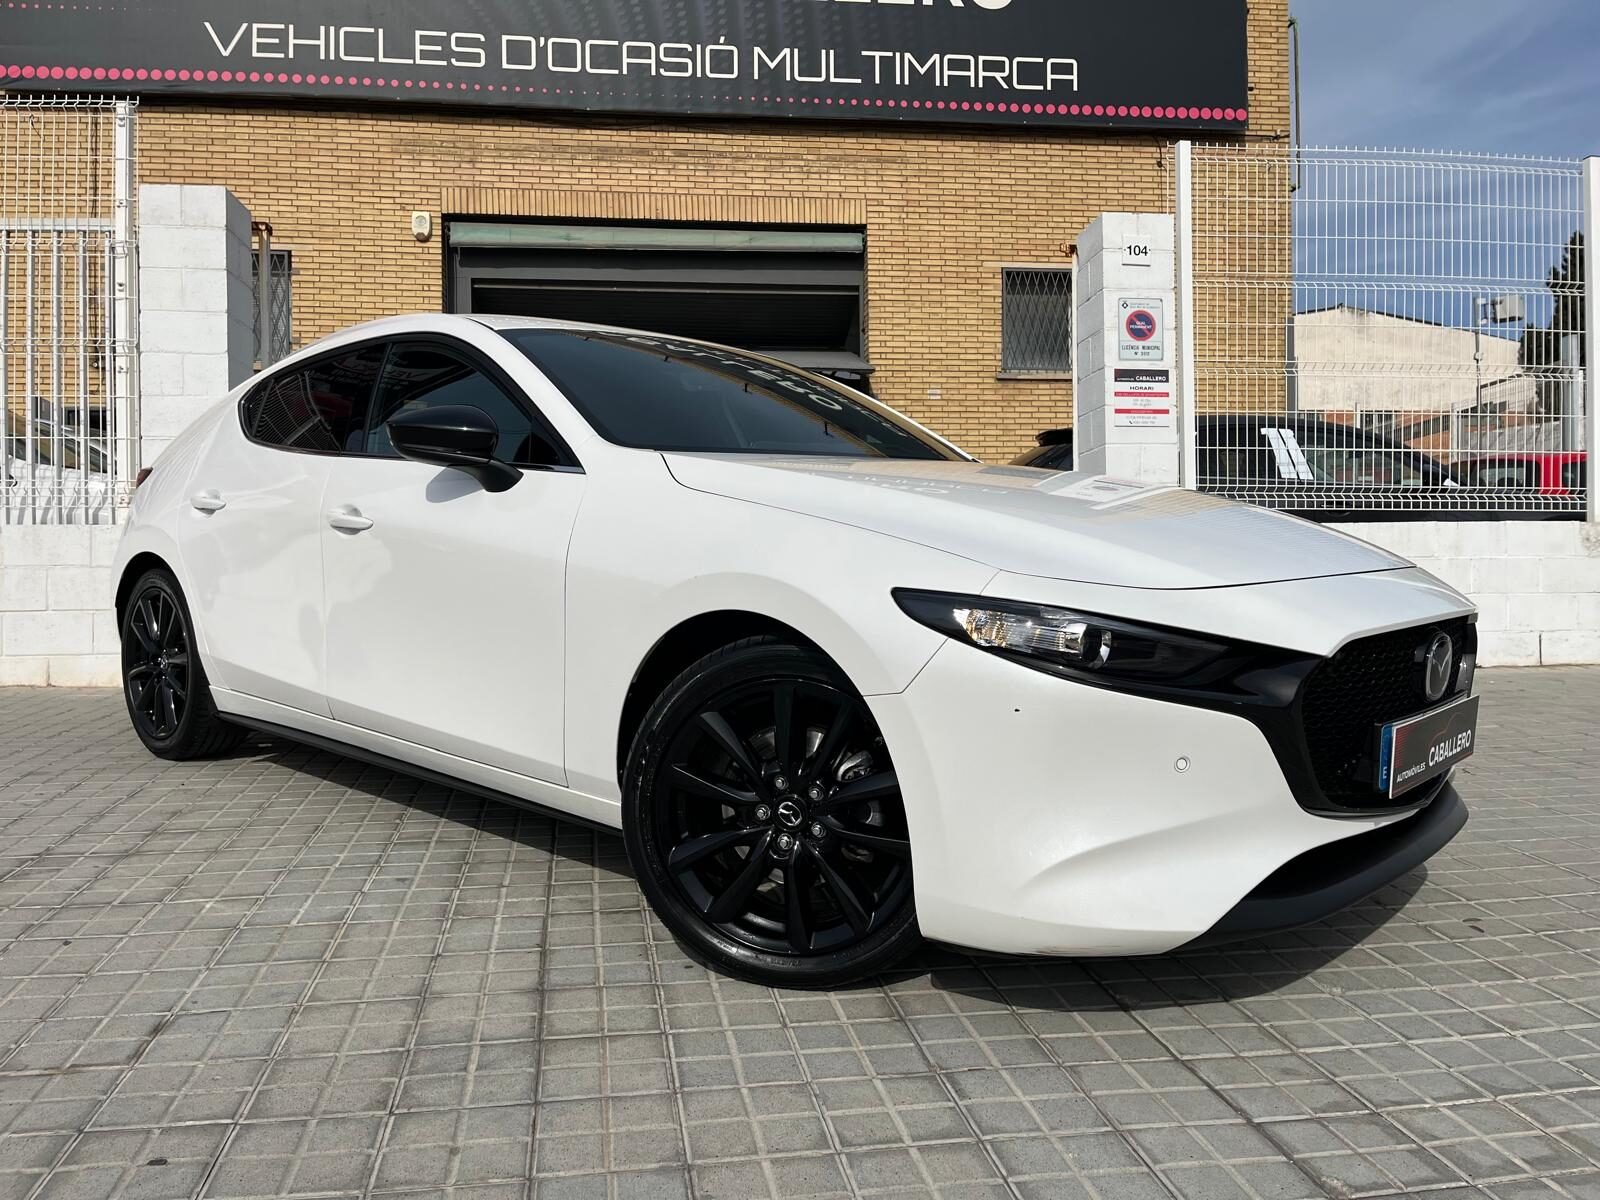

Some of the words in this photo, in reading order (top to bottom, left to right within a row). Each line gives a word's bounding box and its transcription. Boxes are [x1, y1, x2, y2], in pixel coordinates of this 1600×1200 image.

[204, 22, 485, 67] VEHICLES
[502, 35, 738, 78] D'OCASIÓ
[754, 47, 1077, 91] MULTIMARCA
[1126, 244, 1149, 257] 104
[1428, 729, 1472, 767] CABALLERO
[1382, 766, 1388, 779] E
